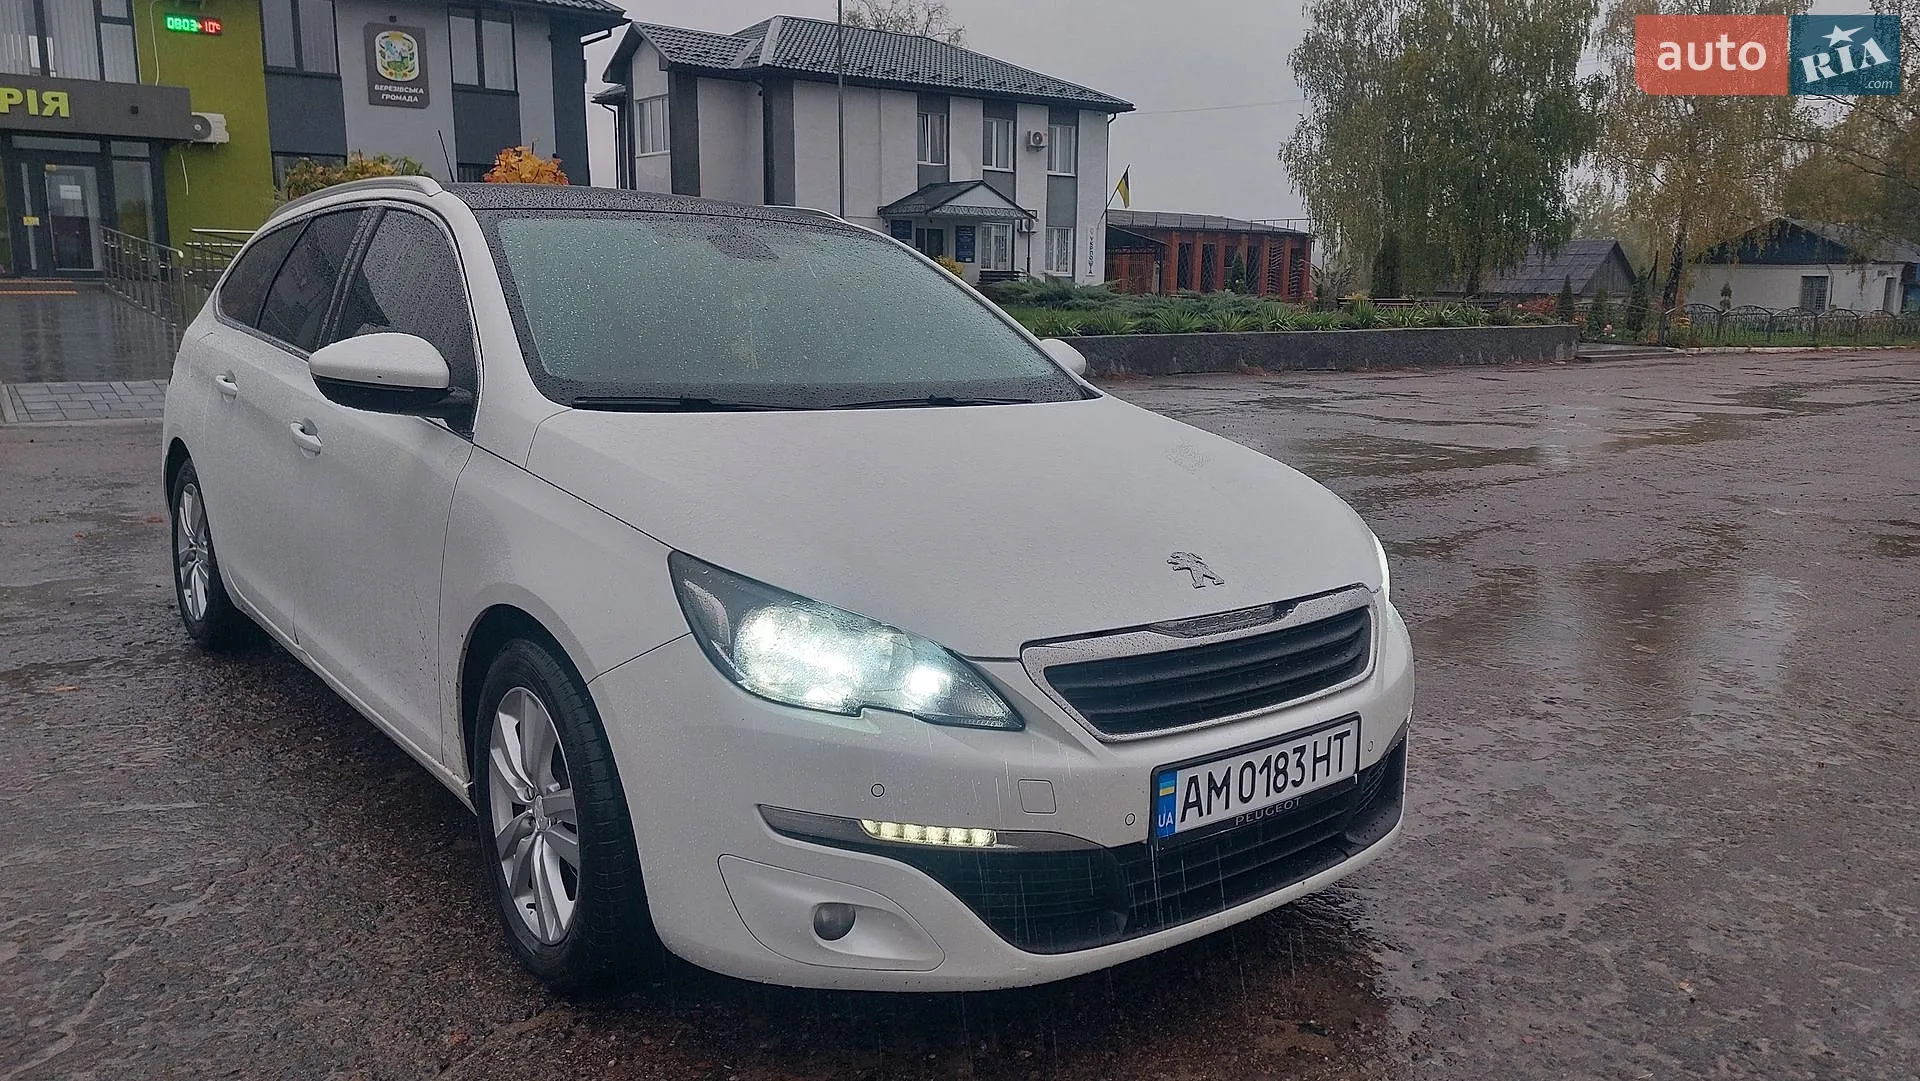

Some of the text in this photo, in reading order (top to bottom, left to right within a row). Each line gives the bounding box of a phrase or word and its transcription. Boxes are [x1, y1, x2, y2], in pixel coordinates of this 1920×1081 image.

[374, 84, 425, 95] БЕРЕЗІВСЬКА
[381, 93, 419, 103] ГРОМАДА
[1235, 797, 1302, 826] PEUGEOT
[1158, 811, 1174, 828] UA
